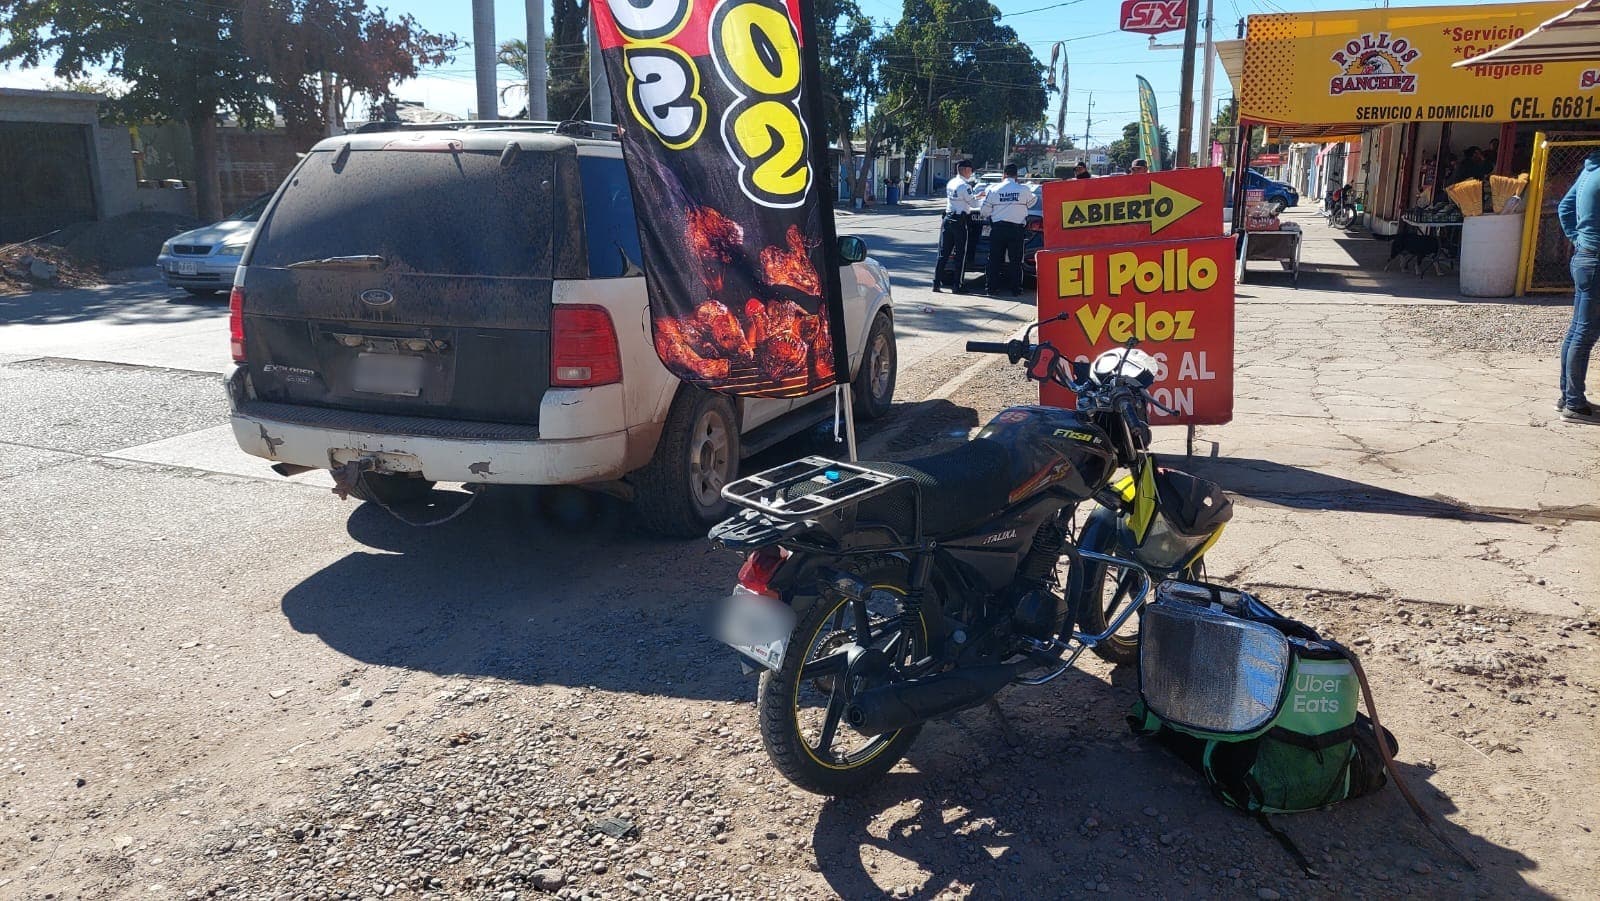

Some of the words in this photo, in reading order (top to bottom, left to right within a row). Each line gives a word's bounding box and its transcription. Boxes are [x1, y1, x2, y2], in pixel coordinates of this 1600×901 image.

[1332, 33, 1418, 66] POLLOS
[1330, 75, 1415, 94] SANCHEZ
[1356, 106, 1412, 120] SERVICIO
[1415, 106, 1423, 119] A
[1428, 104, 1494, 119] DOMICILIO
[1510, 97, 1545, 119] CEL.
[1067, 196, 1174, 225] ABIERTO
[1057, 254, 1094, 297] El
[1108, 248, 1218, 295] Pollo
[1075, 302, 1196, 345] Veloz
[1178, 351, 1216, 381] AL
[1295, 675, 1341, 693] Uber
[1293, 694, 1339, 713] Eats
